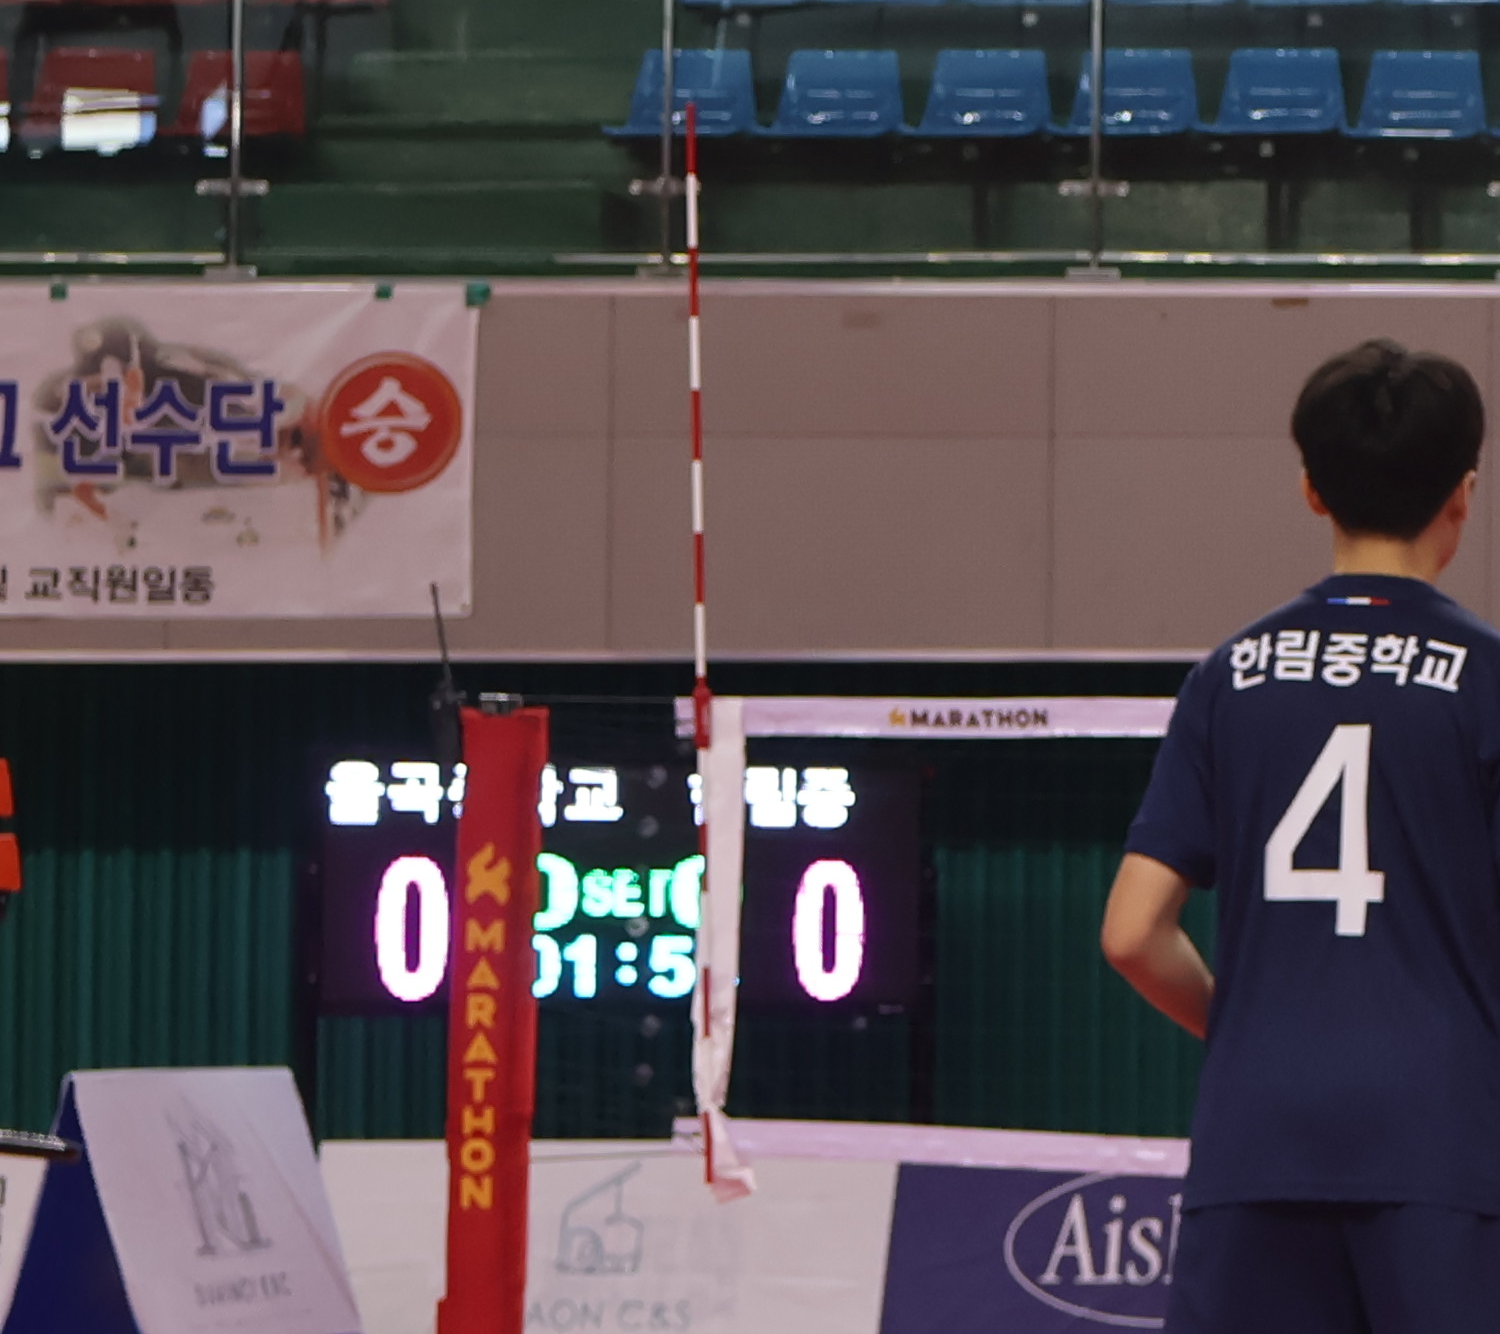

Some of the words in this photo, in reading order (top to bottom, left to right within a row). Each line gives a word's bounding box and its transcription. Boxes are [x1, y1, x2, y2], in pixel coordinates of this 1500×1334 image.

[51, 378, 284, 477] 선수단
[26, 565, 215, 605] 교직원일동
[1229, 628, 1468, 693] 한림중학교
[909, 708, 1049, 730] MARATHON
[1263, 723, 1384, 937] 4
[375, 855, 449, 1003] 0
[793, 859, 865, 1003] 0
[459, 918, 506, 1209] MARATHON
[1039, 1192, 1181, 1286] Ais
[526, 1298, 604, 1332] AON
